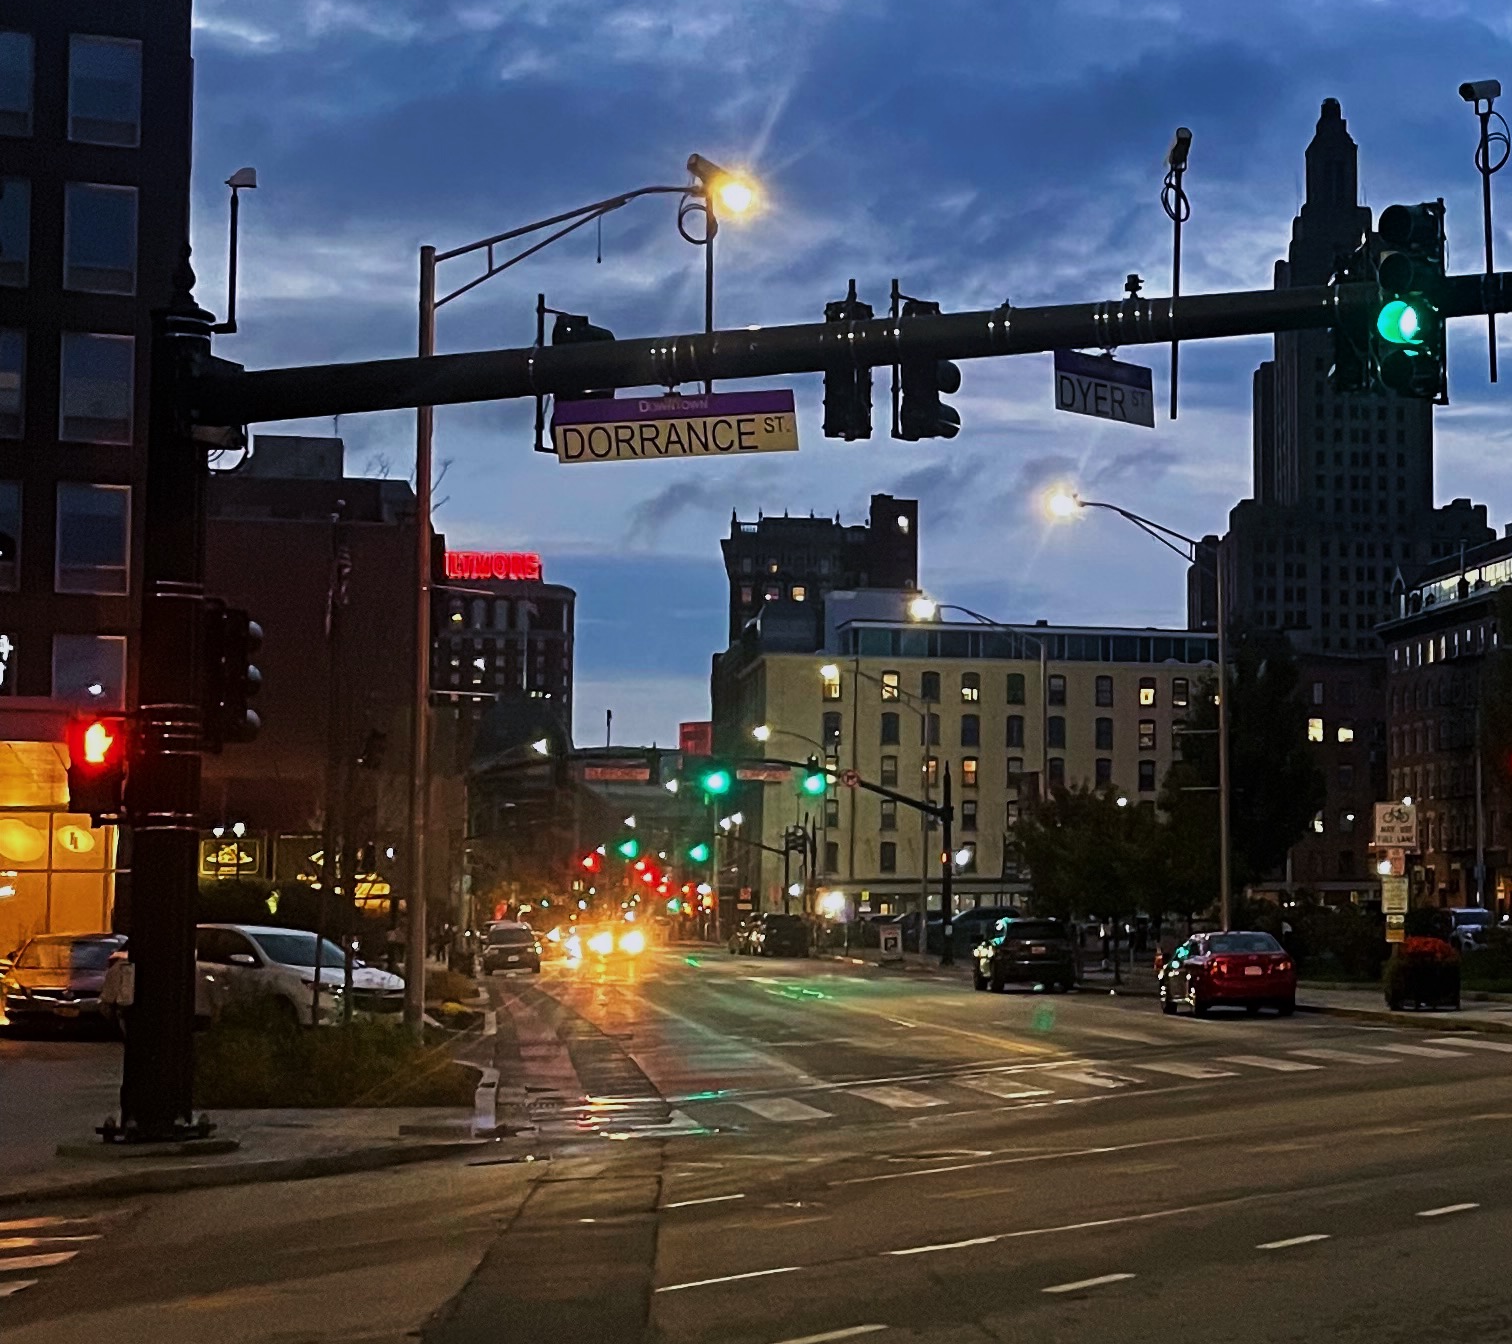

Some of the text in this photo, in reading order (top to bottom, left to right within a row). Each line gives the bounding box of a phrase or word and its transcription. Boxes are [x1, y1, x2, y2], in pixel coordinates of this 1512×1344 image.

[1060, 375, 1127, 419] DYER
[562, 418, 758, 460] DORRANCE
[444, 551, 540, 580] ILTMORE
